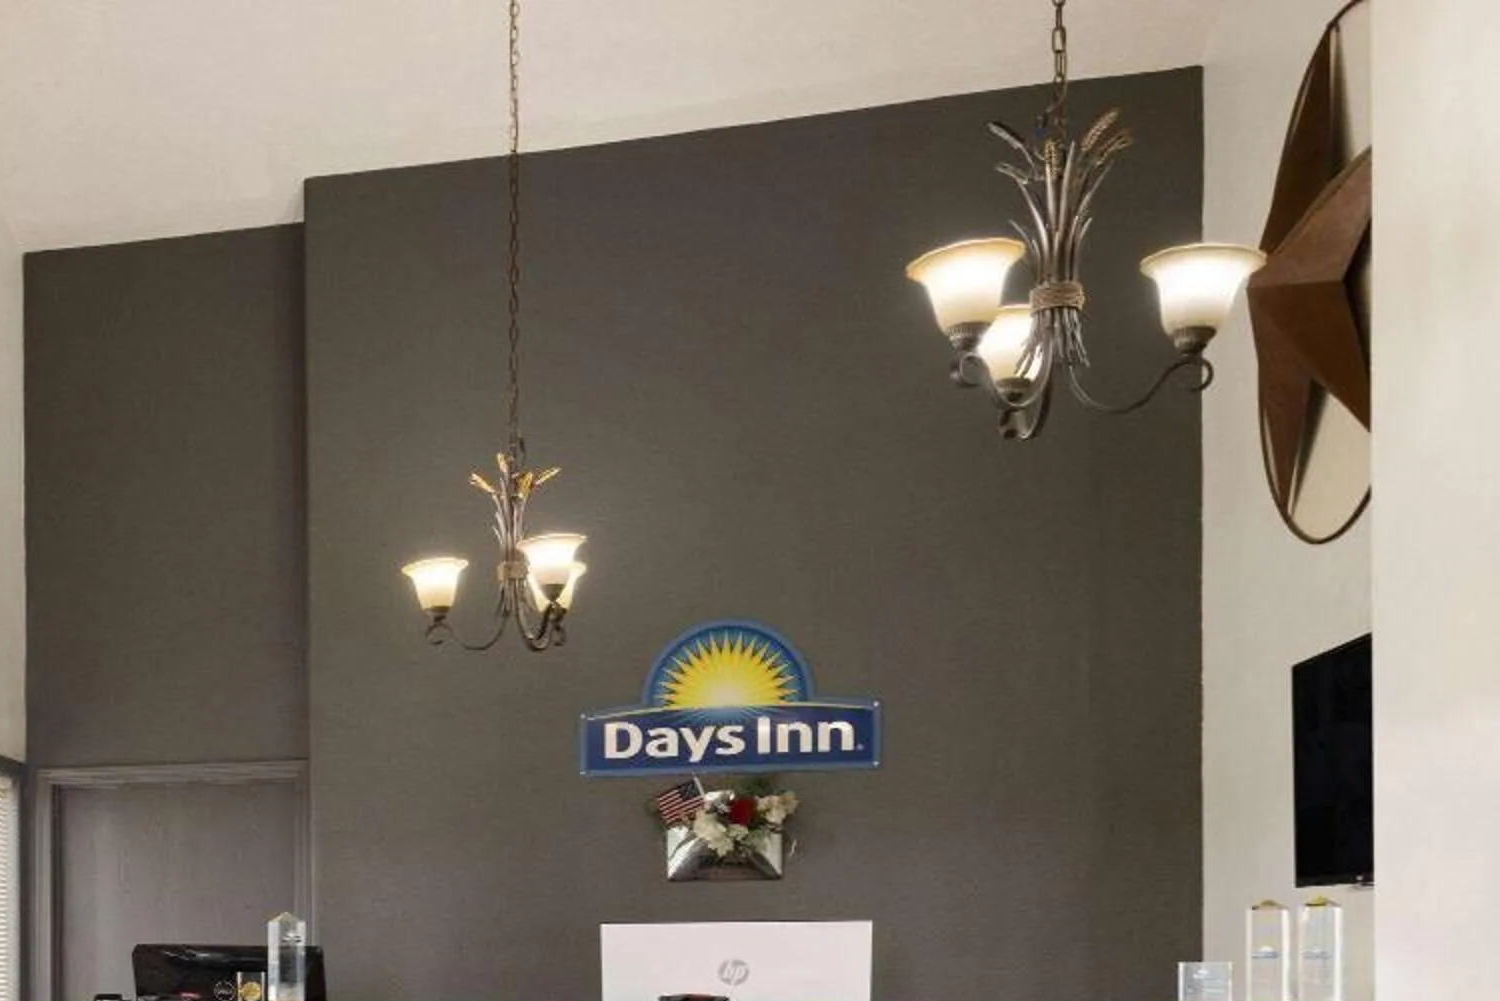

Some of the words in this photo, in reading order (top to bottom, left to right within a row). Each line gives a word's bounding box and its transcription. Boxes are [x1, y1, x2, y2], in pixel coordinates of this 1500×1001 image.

[604, 720, 746, 763] Days
[757, 716, 856, 755] Inn
[719, 959, 750, 986] hp
